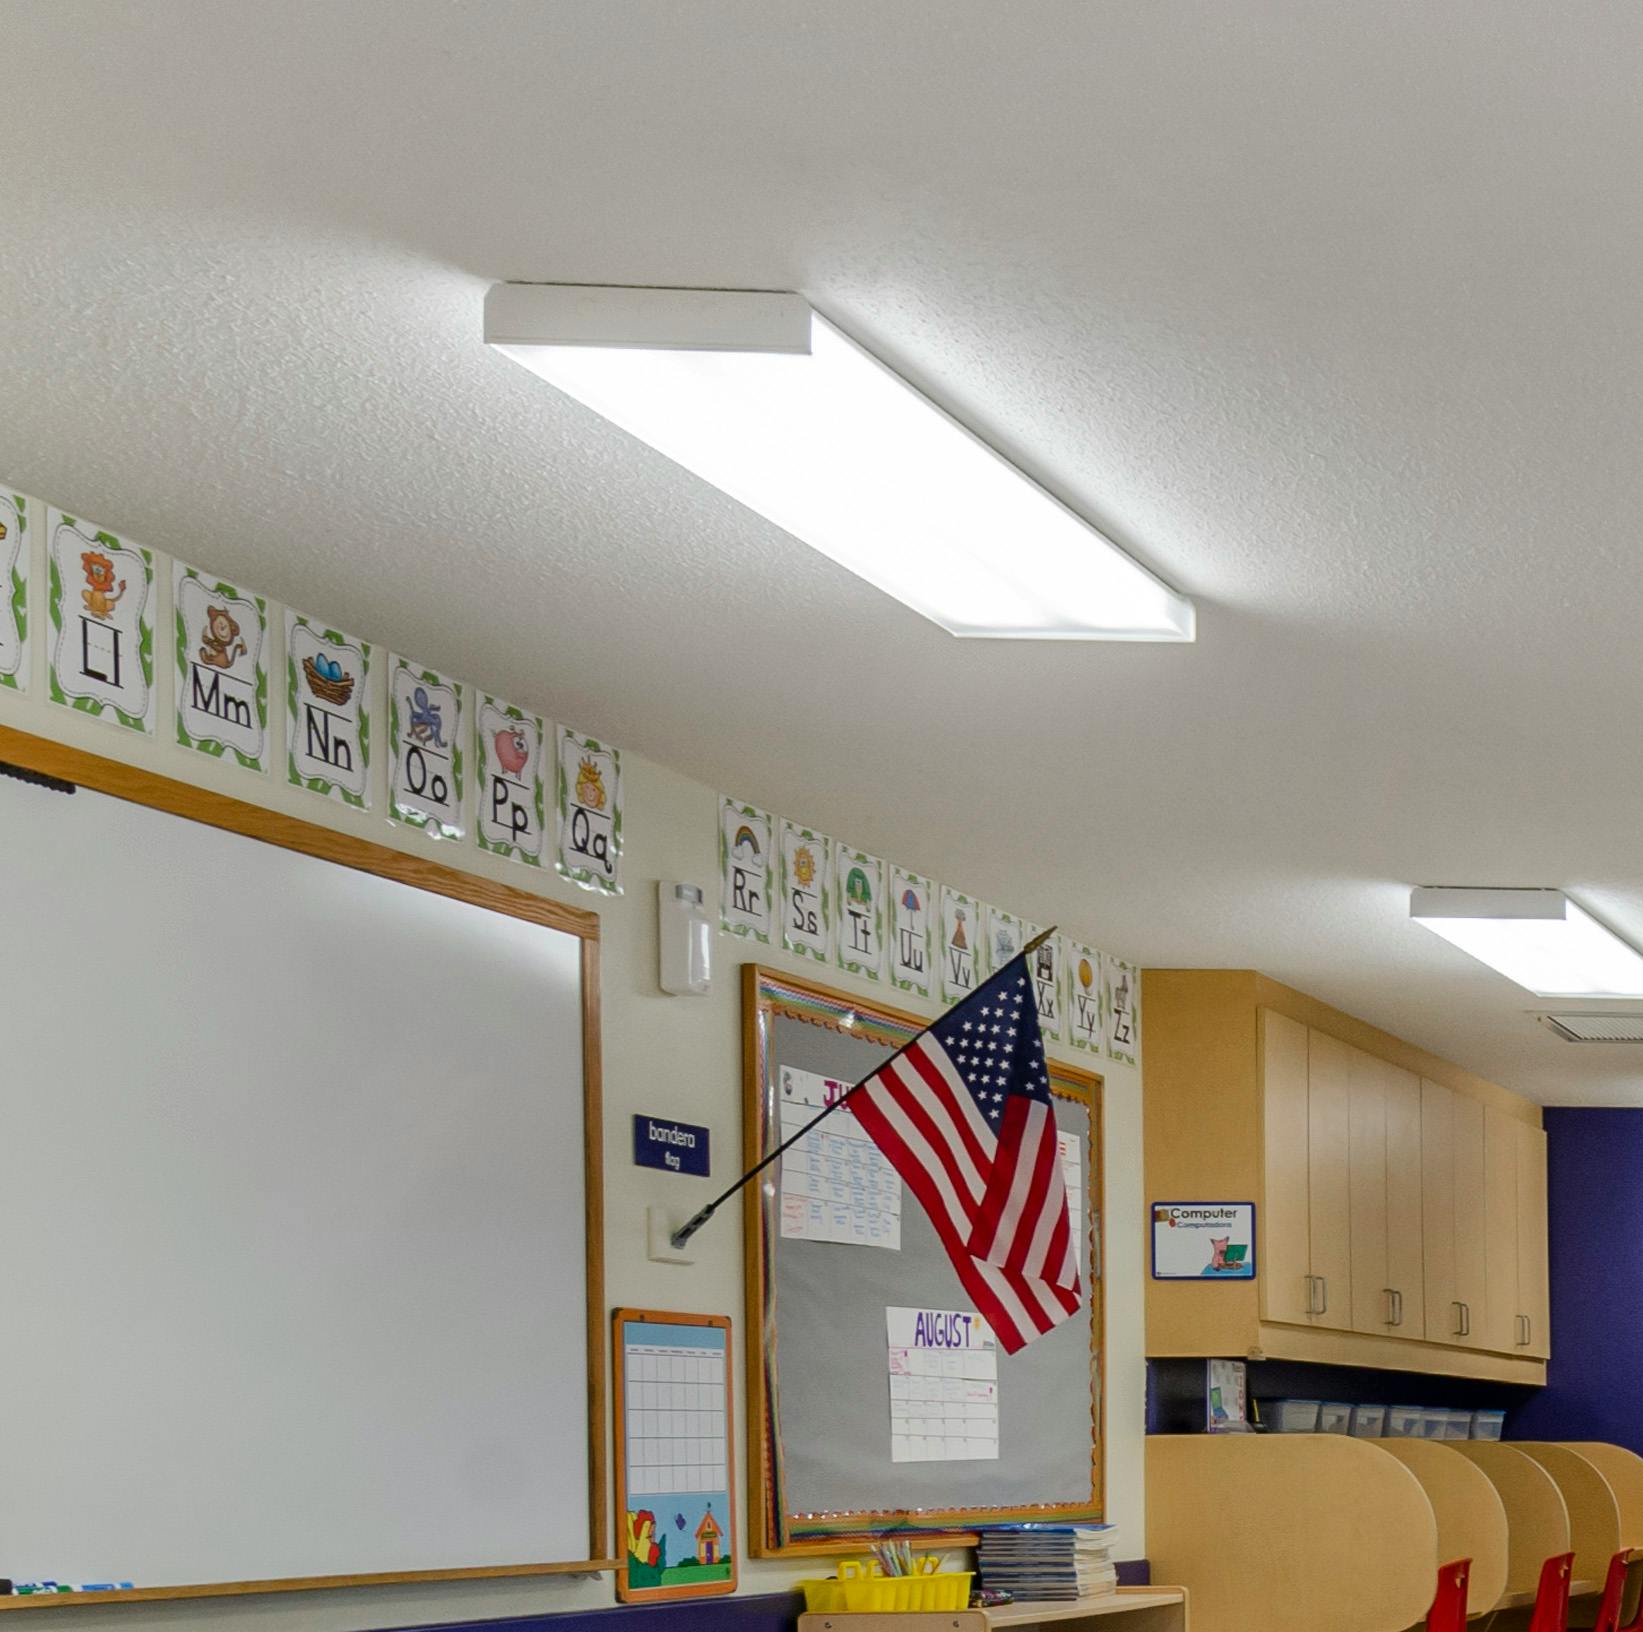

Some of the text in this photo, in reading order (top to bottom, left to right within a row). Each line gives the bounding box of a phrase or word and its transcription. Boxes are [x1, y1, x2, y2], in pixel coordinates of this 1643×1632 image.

[81, 617, 122, 687] Ll
[192, 663, 252, 727] Mm
[306, 703, 353, 771] Nn
[406, 746, 448, 803] Oo
[494, 775, 528, 840] Pp
[573, 806, 612, 874] Qq
[733, 868, 760, 914] Rr
[793, 890, 819, 935] Ss
[848, 911, 871, 953] Tt
[901, 930, 923, 972] Uu
[951, 948, 970, 987] Vv
[1037, 981, 1054, 1018] Xx
[1077, 996, 1095, 1037] Yy
[1114, 1009, 1130, 1043] Zz
[648, 1120, 696, 1148] bandera
[664, 1150, 680, 1171] flag
[1169, 1208, 1238, 1220] Computer
[915, 1312, 971, 1347] AUGUST
